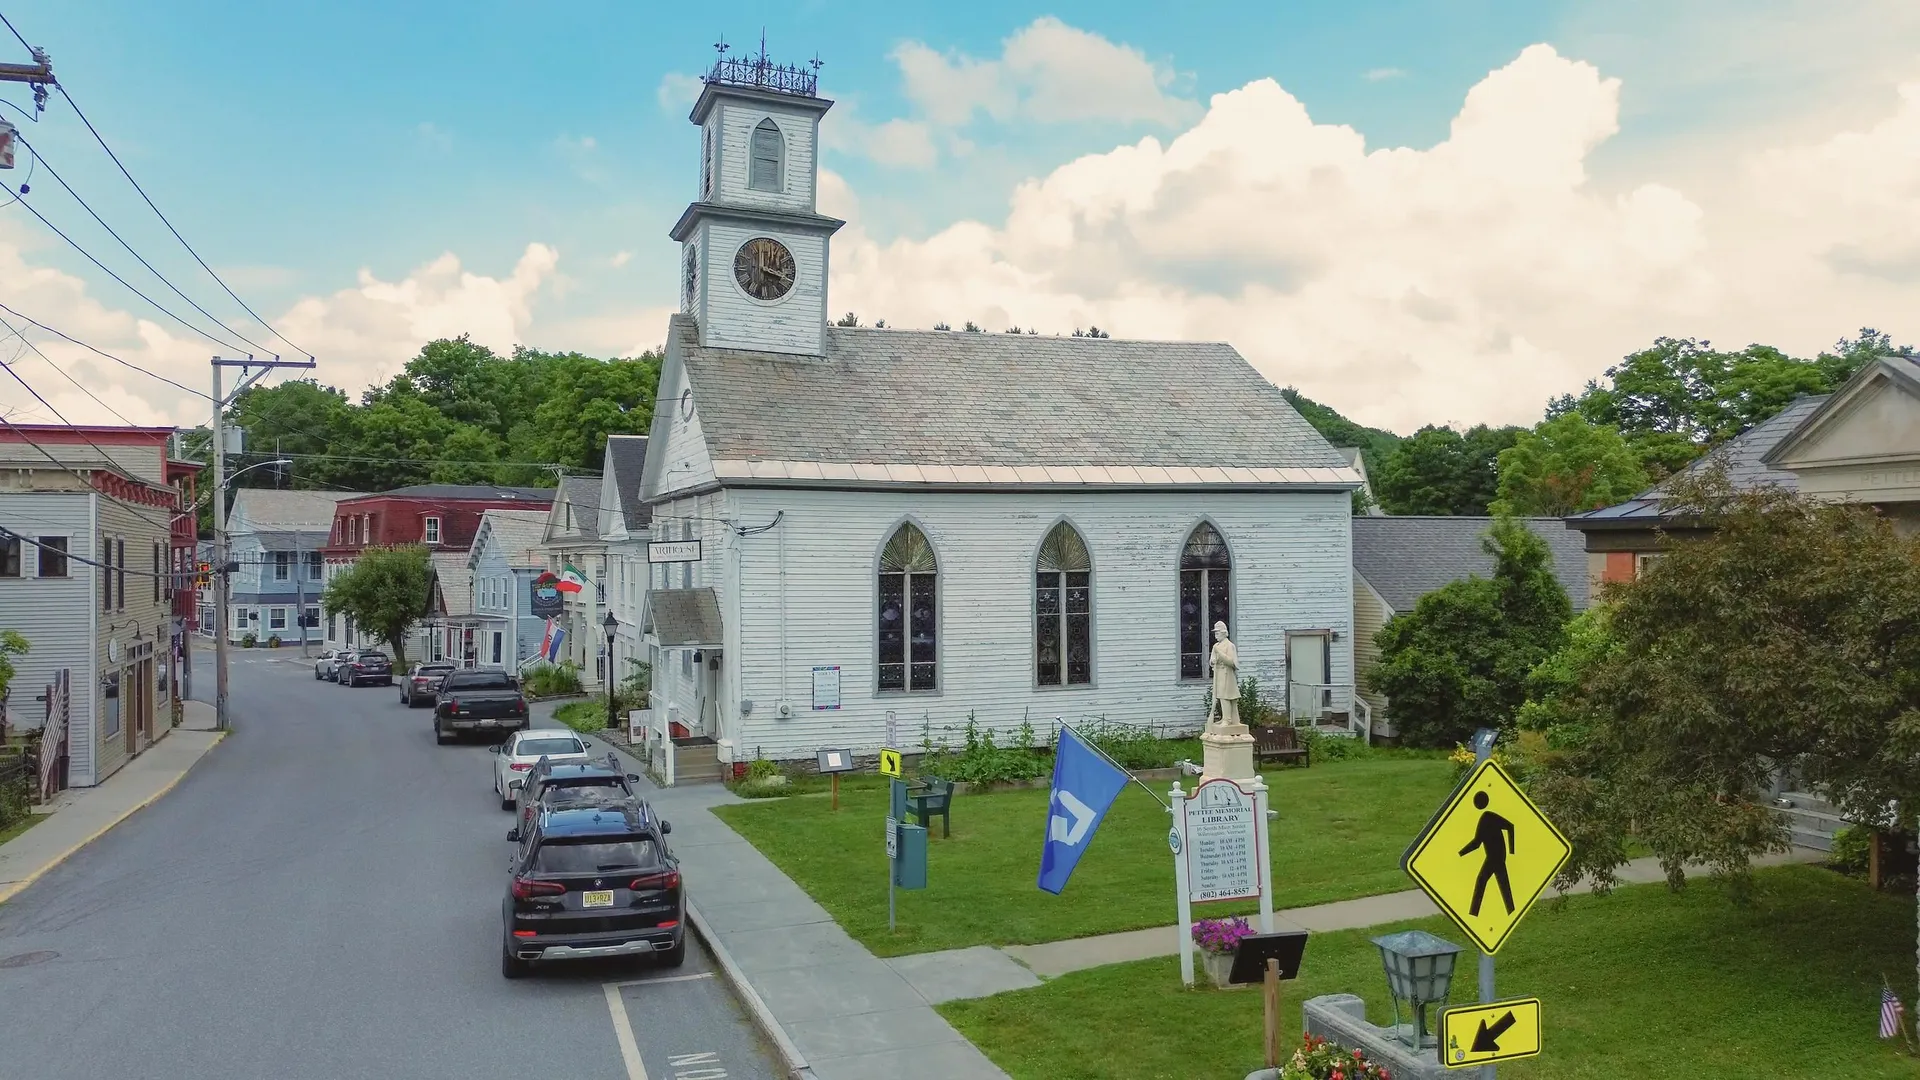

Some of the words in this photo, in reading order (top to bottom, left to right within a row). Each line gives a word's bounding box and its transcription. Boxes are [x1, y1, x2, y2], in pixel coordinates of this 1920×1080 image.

[1202, 815, 1239, 823] LIBRARY
[1200, 890, 1217, 899] (802)
[1219, 887, 1250, 897] 464-8557
